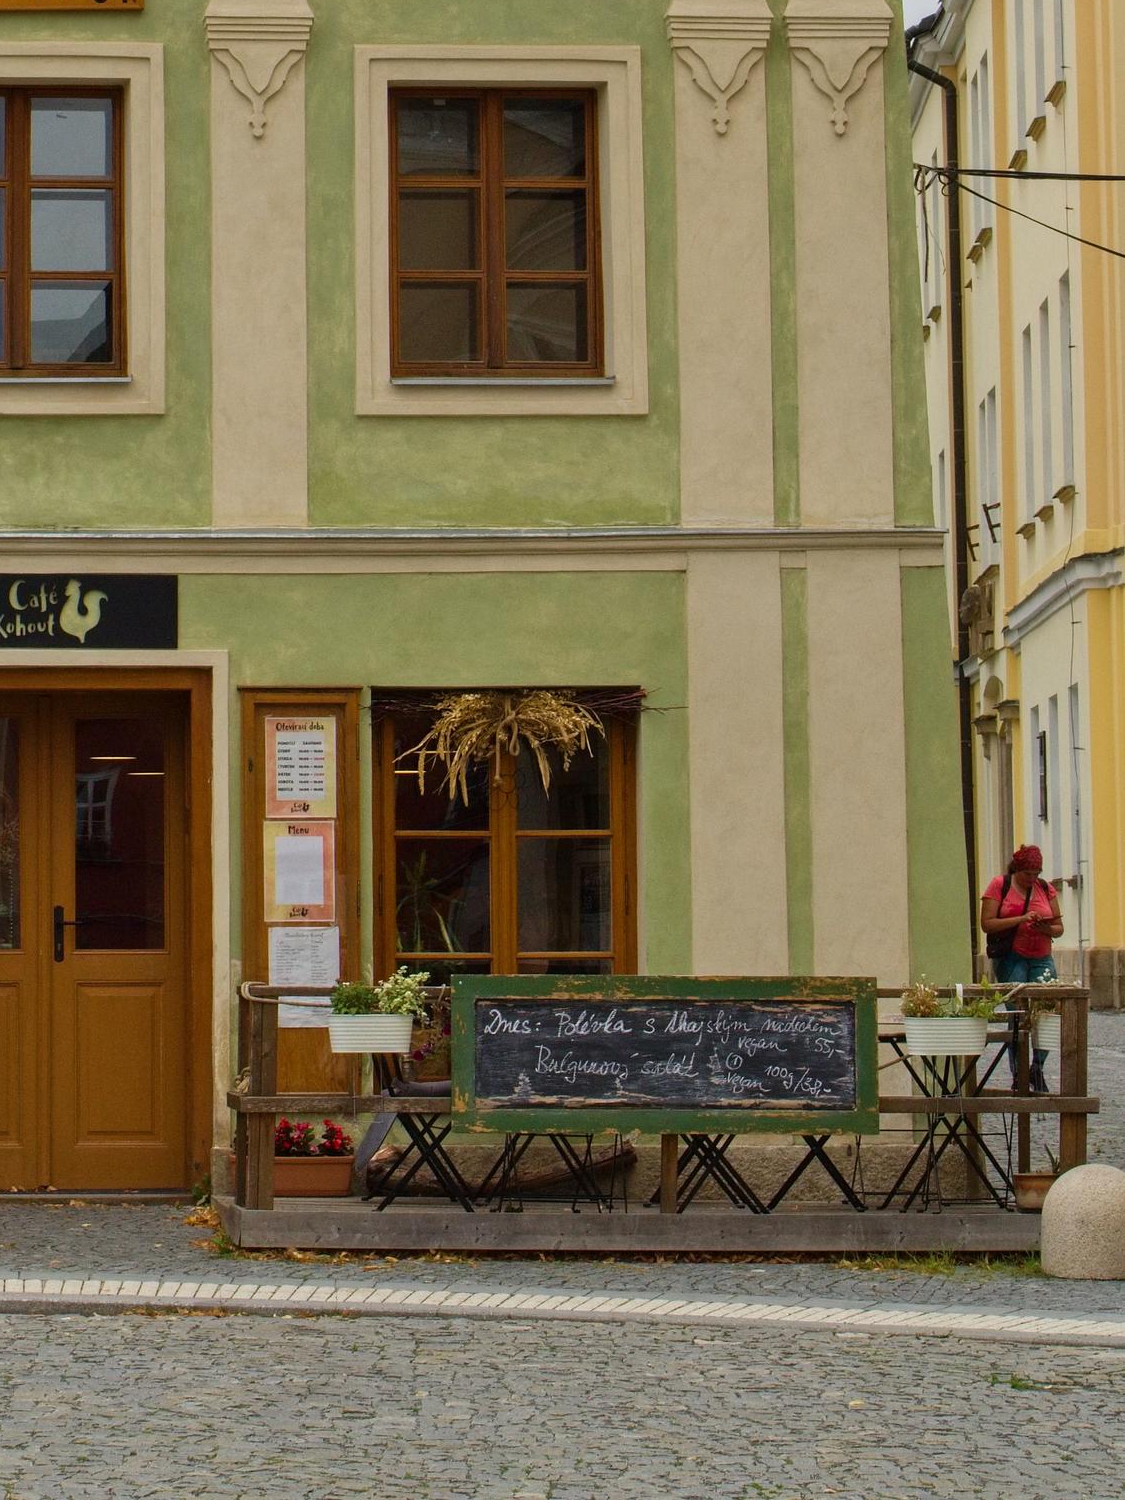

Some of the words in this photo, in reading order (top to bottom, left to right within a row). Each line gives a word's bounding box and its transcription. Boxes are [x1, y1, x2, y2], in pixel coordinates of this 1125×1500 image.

[8, 579, 58, 613] Café
[288, 825, 310, 835] Menu
[484, 1008, 542, 1035] Dnes:
[555, 1008, 633, 1038] Polévka
[738, 1036, 788, 1057] vegan
